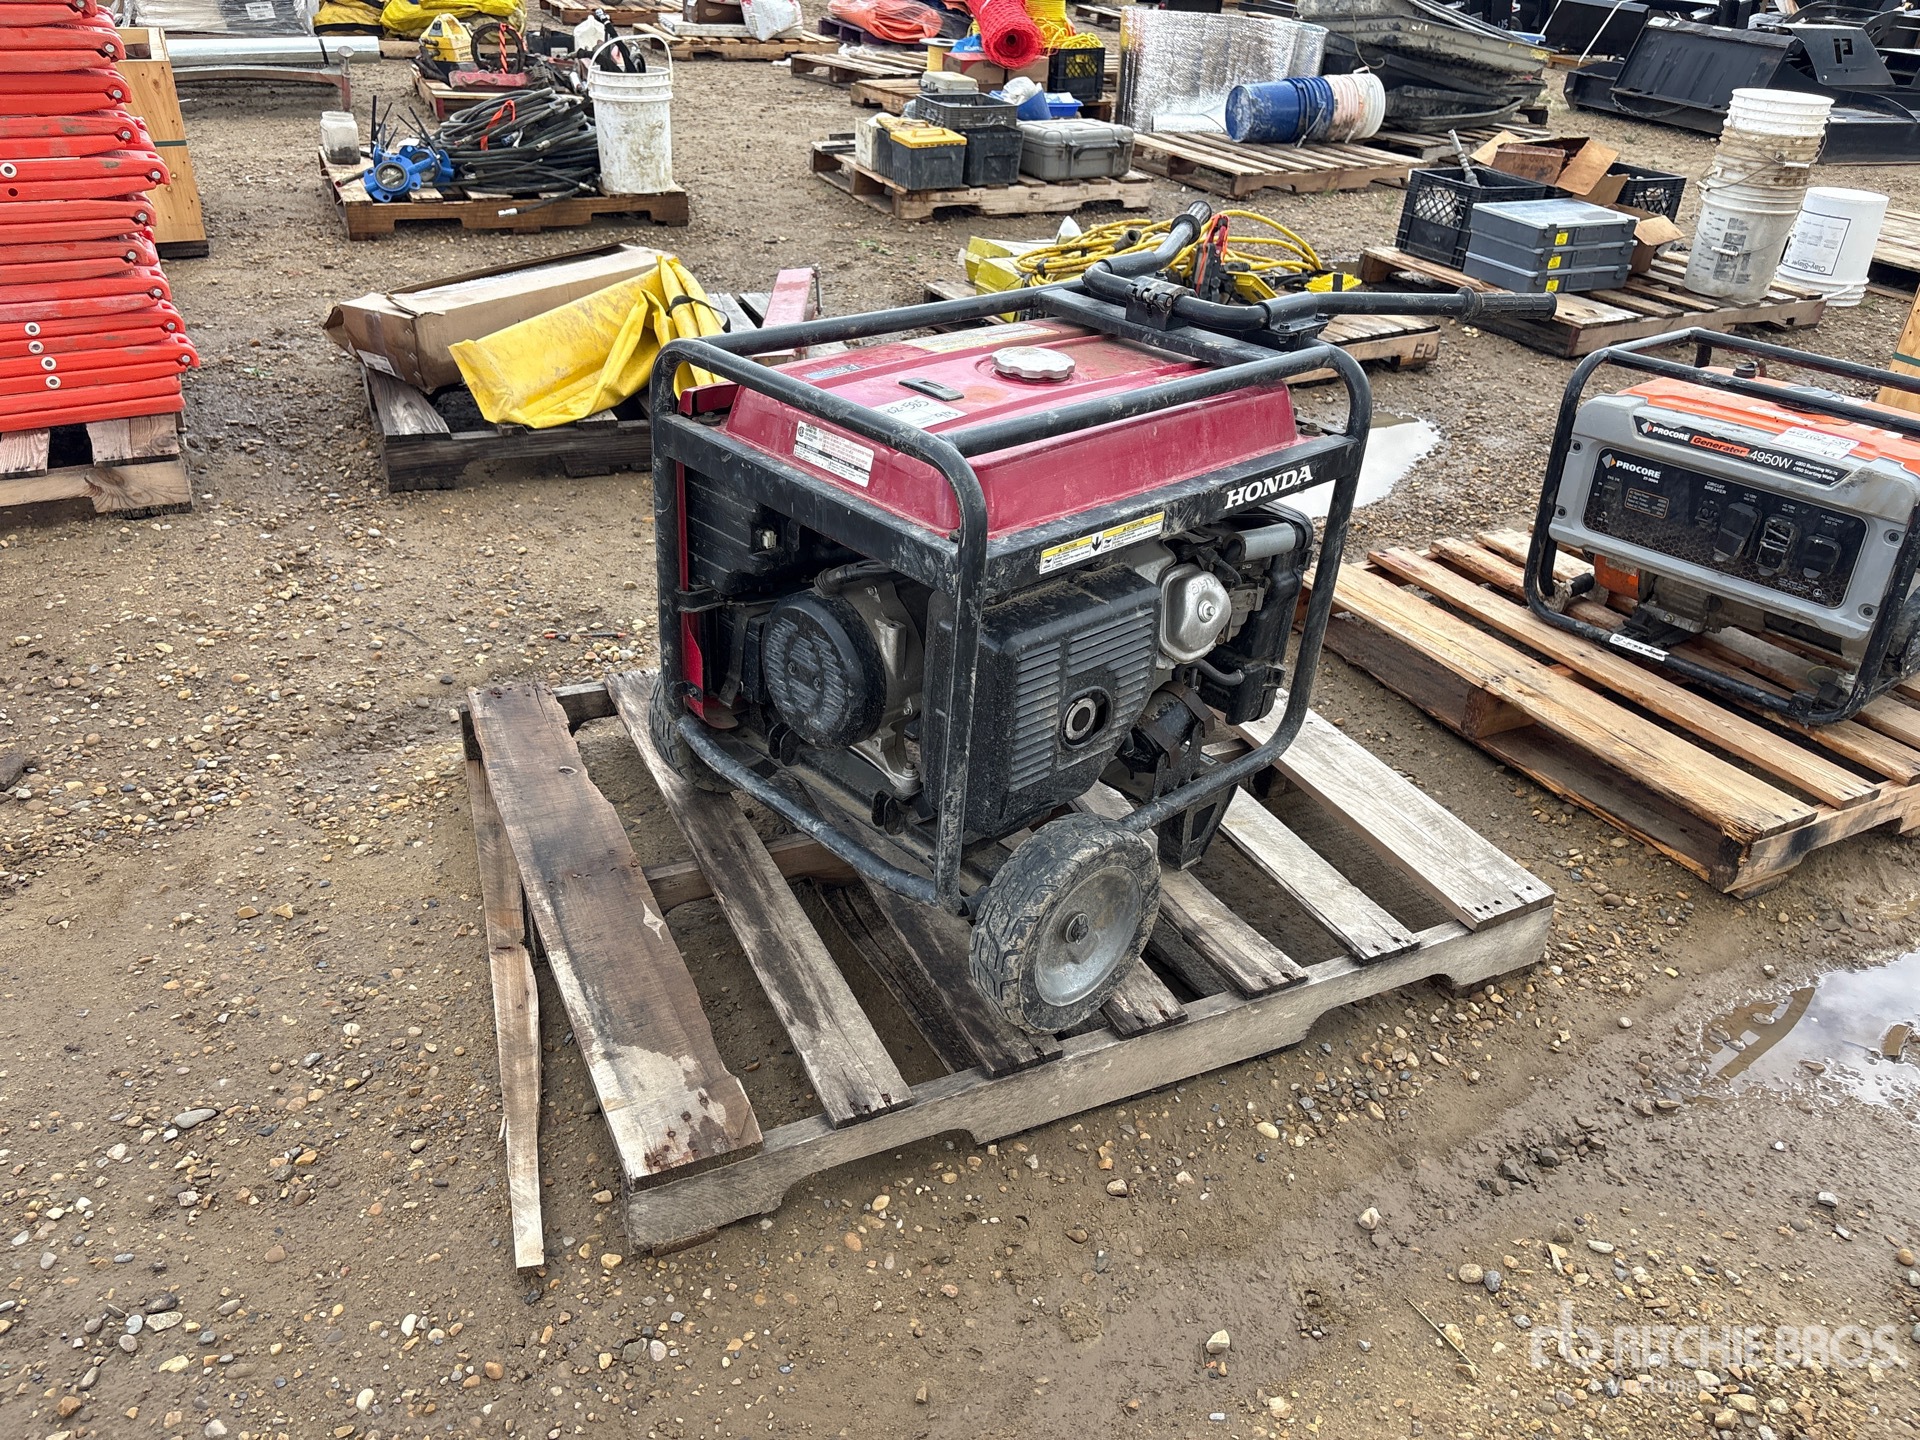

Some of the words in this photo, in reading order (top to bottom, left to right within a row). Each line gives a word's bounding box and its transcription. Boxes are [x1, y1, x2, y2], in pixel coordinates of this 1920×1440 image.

[1791, 260, 1826, 273] Clay-Slayer
[1653, 426, 1691, 442] PROCORE
[1693, 437, 1746, 454] Generator
[1750, 450, 1793, 469] 4950W
[1616, 460, 1662, 479] PROCORE
[1804, 467, 1822, 479] Starting
[1806, 461, 1825, 473] Running
[1224, 465, 1313, 510] HONDA
[1704, 485, 1727, 495] BREAKER
[1706, 481, 1725, 490] CIRCUIT
